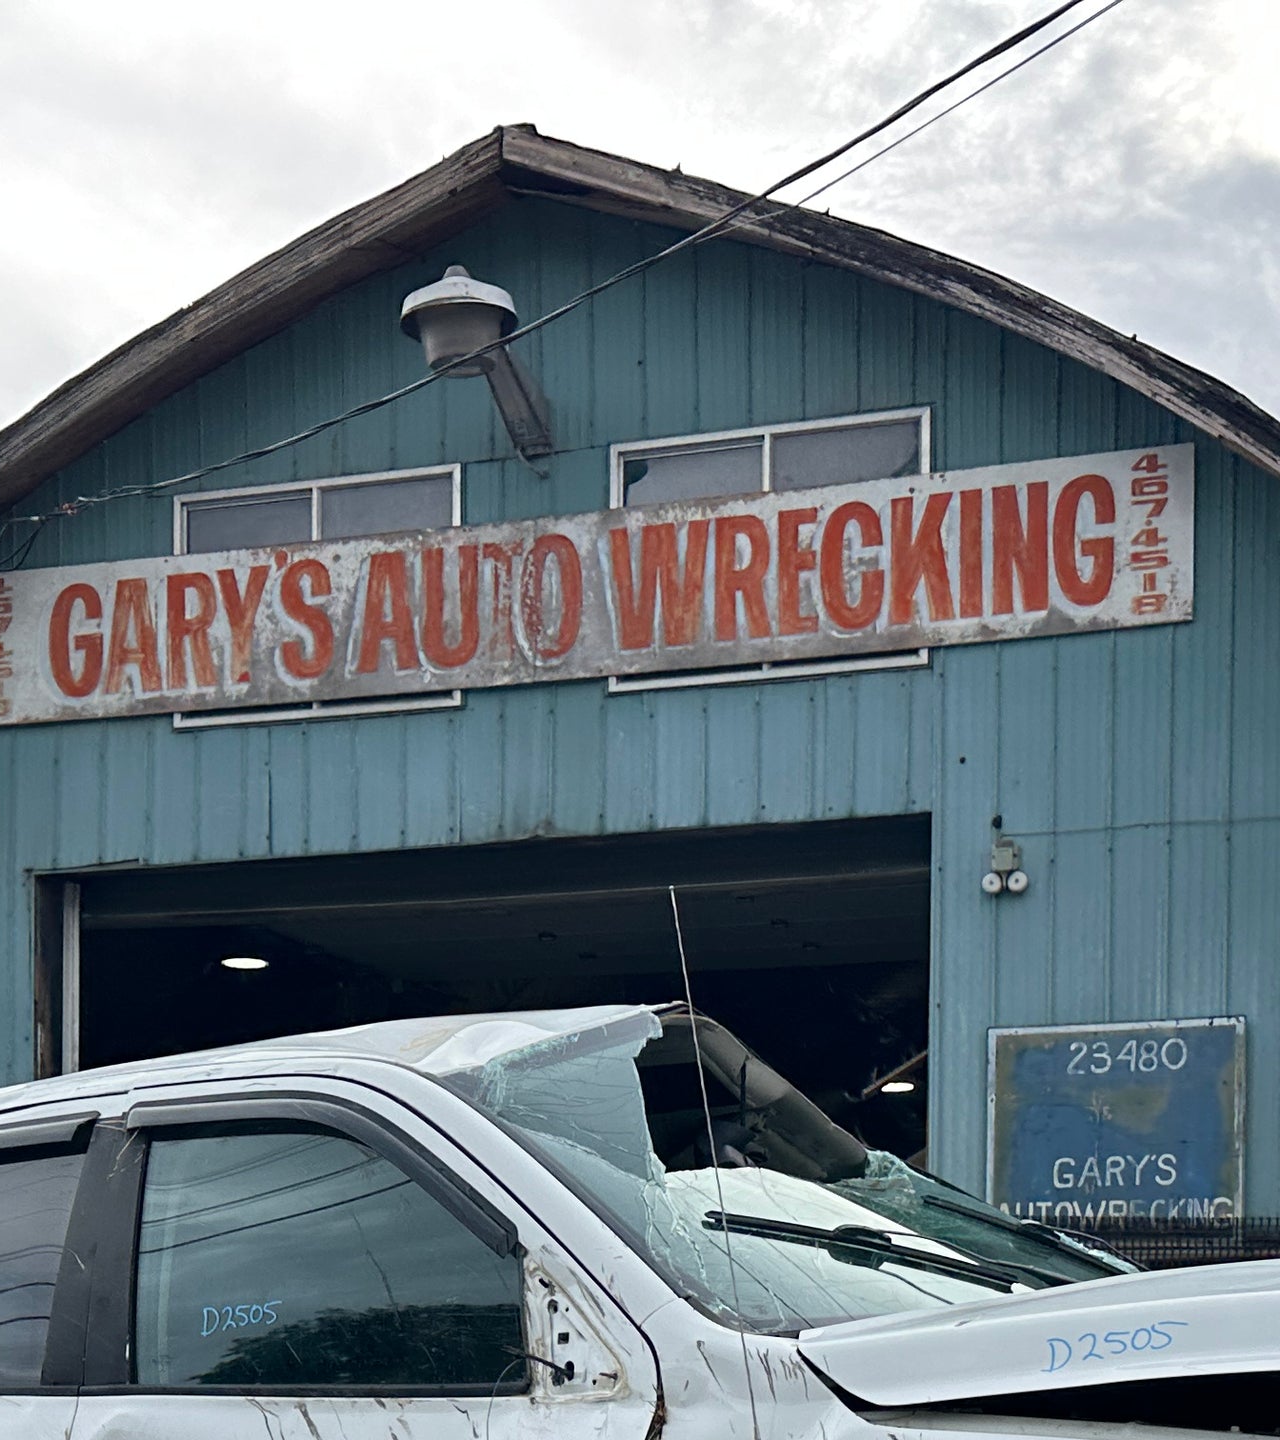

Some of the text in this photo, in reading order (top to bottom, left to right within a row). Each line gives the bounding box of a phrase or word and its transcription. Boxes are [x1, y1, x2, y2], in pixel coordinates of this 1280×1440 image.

[47, 473, 1117, 699] GARY'S AUTO WRECKING
[1066, 1037, 1188, 1075] 23480
[1052, 1153, 1178, 1189] GARY'S
[201, 1300, 283, 1336] D2505
[1041, 1321, 1189, 1373] D2505
